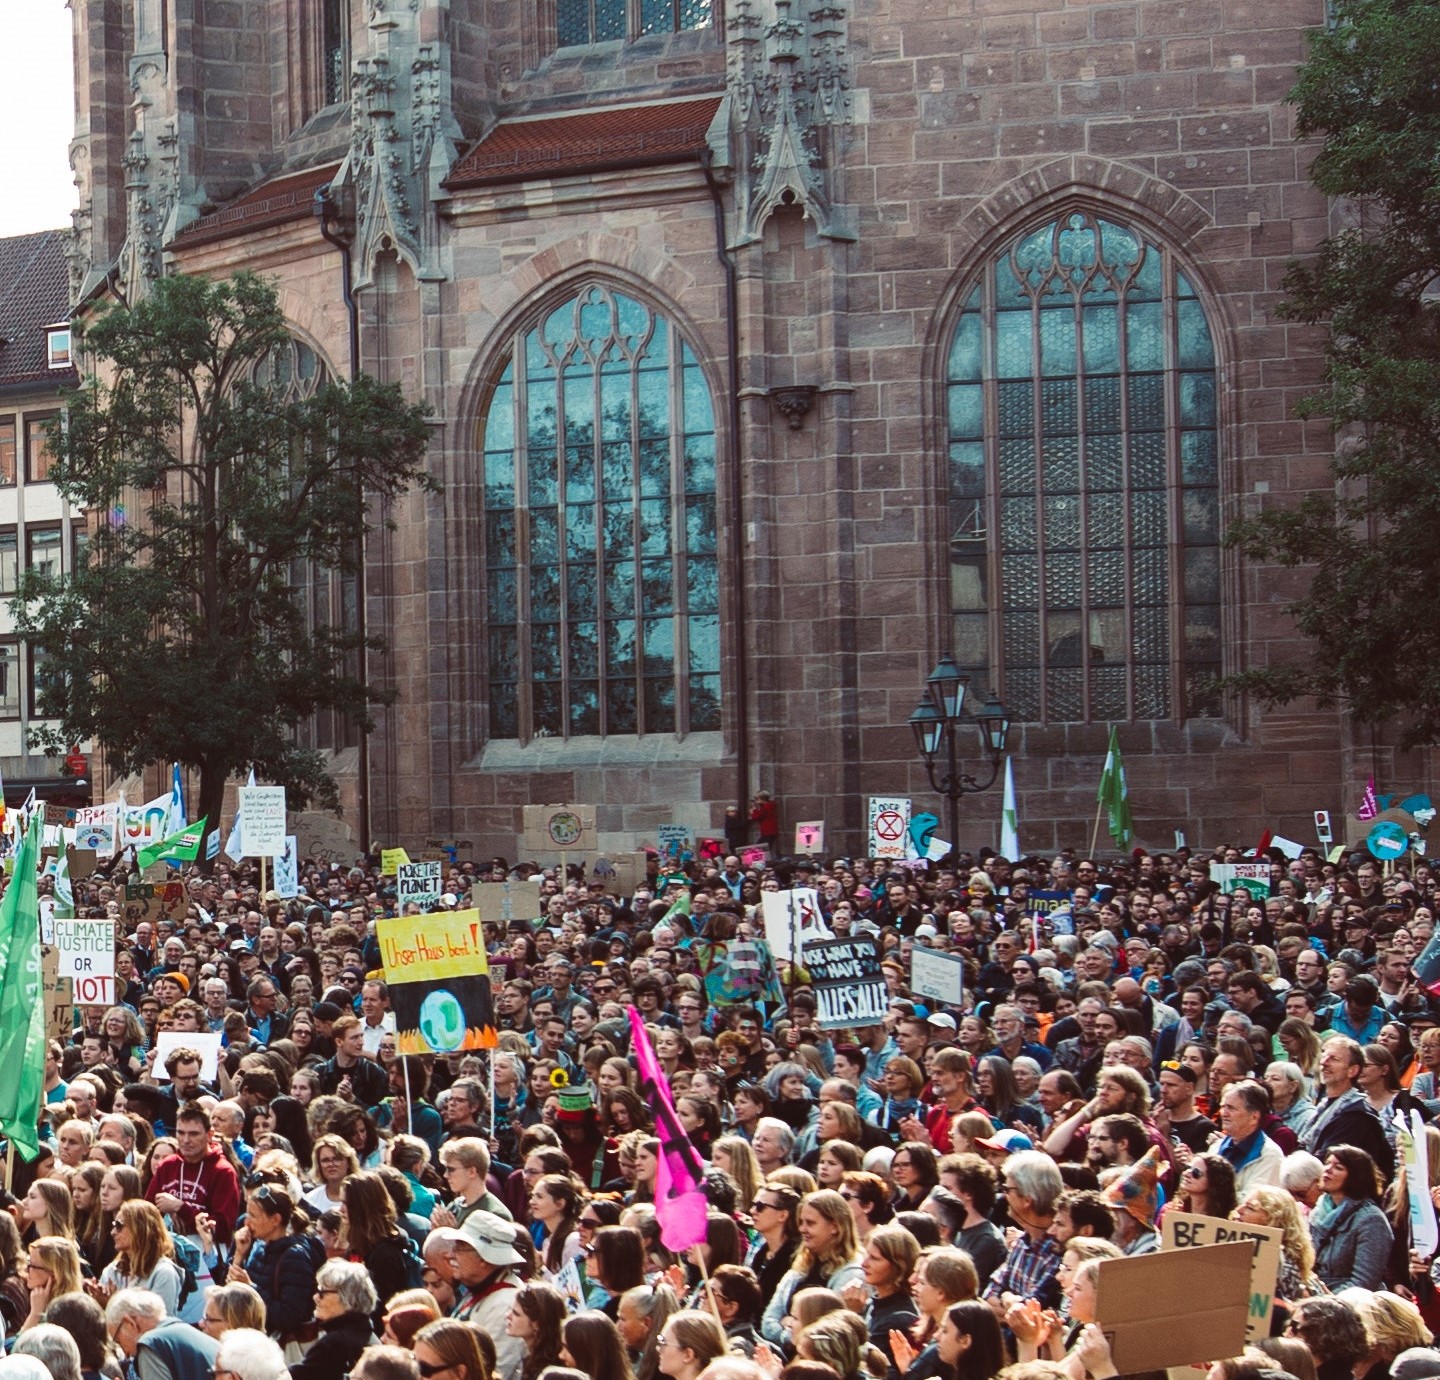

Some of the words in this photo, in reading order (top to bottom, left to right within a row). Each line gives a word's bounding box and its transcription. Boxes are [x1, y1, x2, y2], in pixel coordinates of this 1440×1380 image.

[424, 862, 440, 876] THE
[55, 922, 114, 938] CLIMATE
[56, 936, 113, 952] JUSTICE
[804, 947, 824, 966] USE
[824, 944, 853, 963] WHAT
[855, 942, 876, 958] YOU
[74, 957, 92, 971] OR
[828, 959, 864, 979] HAVE
[73, 975, 114, 1002] IOT
[1173, 1221, 1206, 1248] BE
